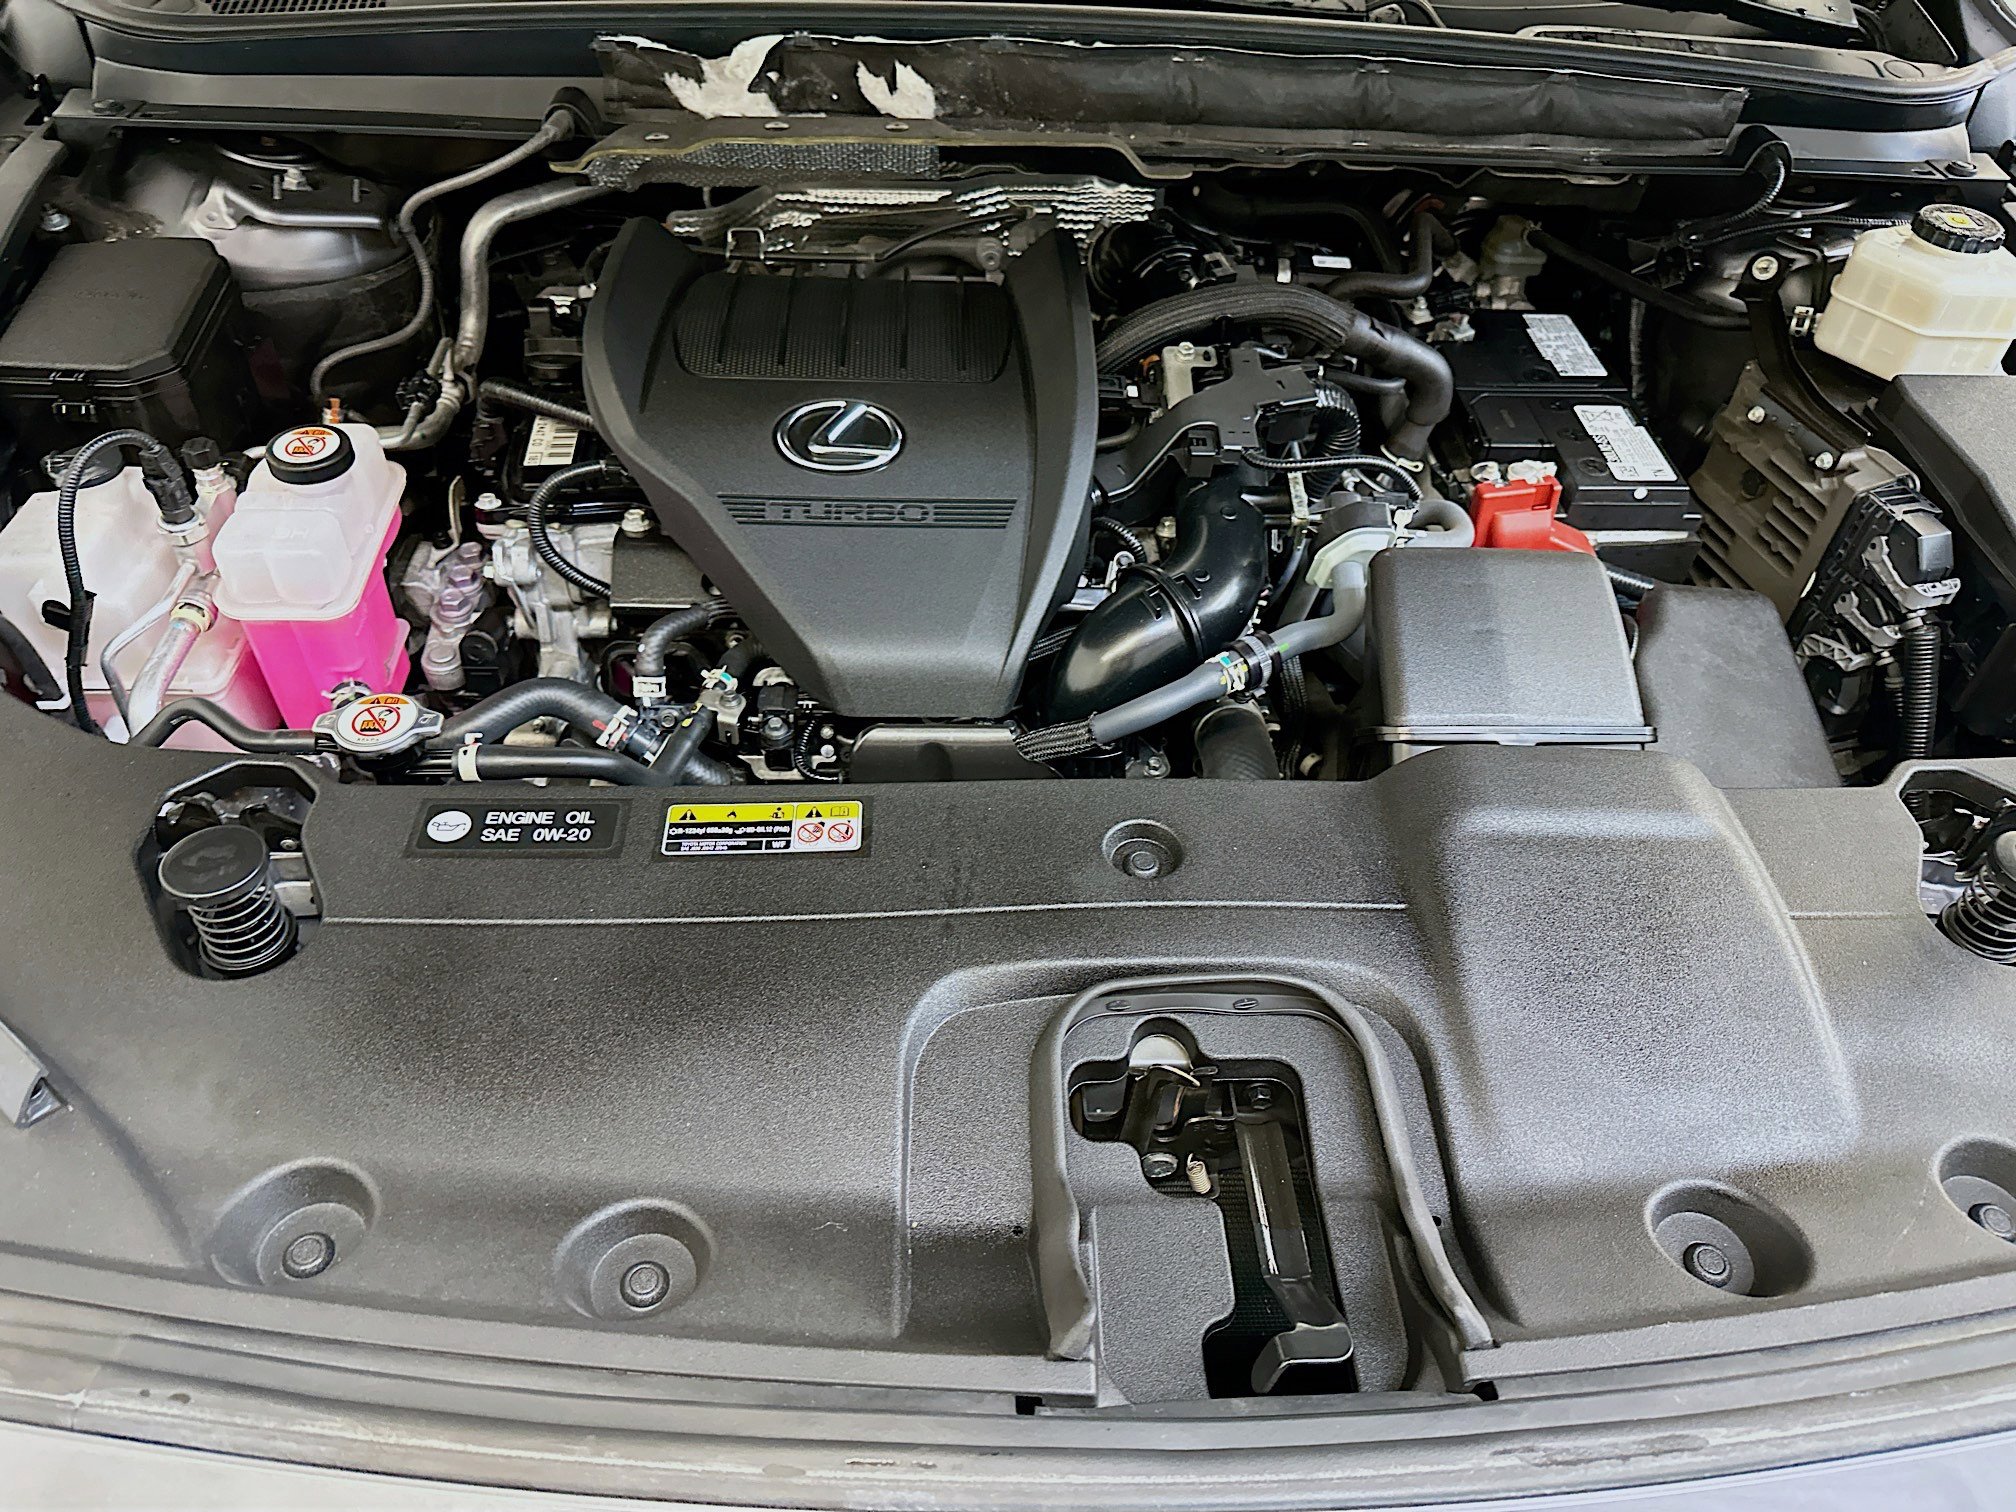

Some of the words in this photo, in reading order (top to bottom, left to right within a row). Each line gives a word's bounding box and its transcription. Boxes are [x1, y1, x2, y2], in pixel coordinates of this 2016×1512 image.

[768, 502, 930, 522] TURBO
[485, 811, 556, 825] ENGINE
[565, 811, 596, 825] OIL
[480, 828, 522, 842] SAE
[532, 828, 592, 842] 0W-20
